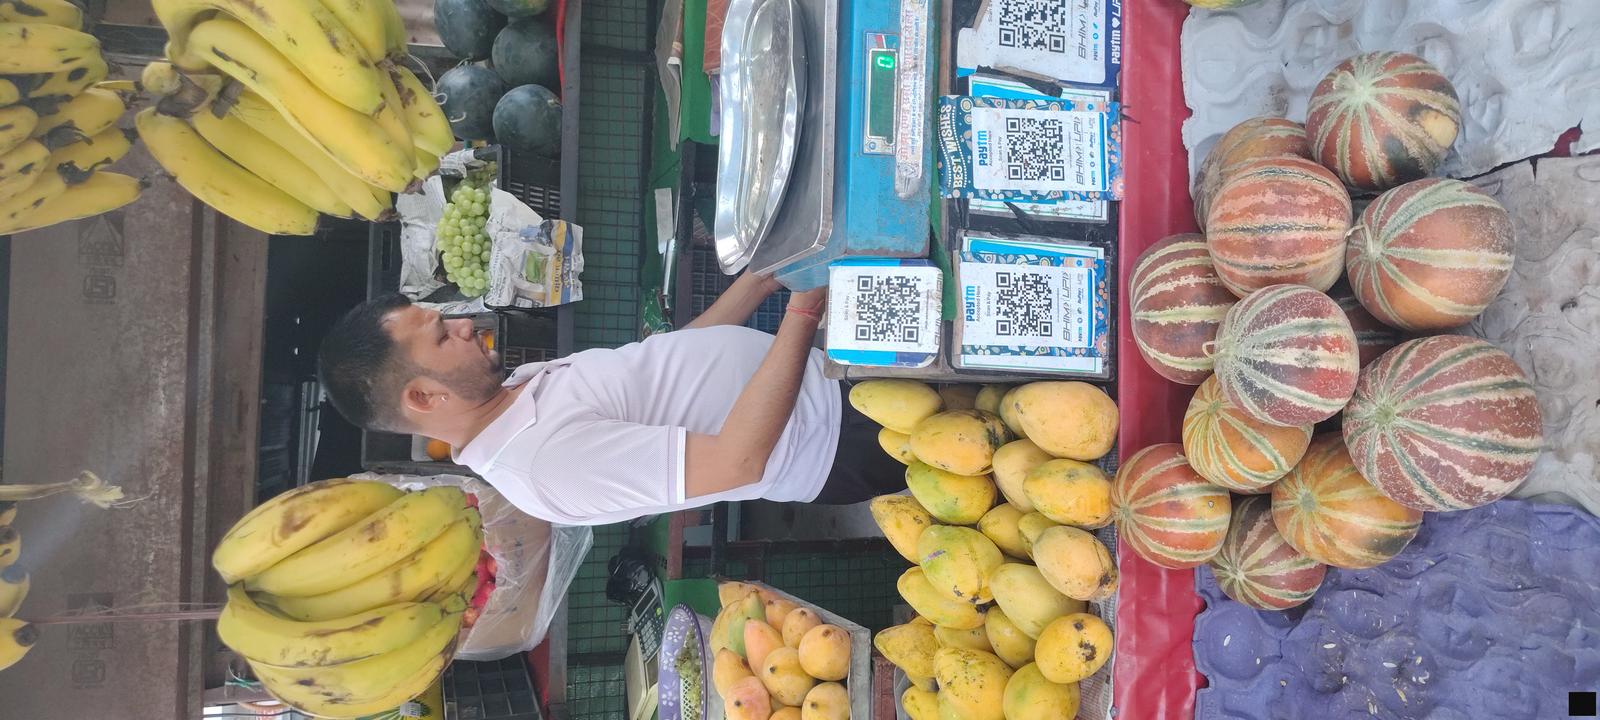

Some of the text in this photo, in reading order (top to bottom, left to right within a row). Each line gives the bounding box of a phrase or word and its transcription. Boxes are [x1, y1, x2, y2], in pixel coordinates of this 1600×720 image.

[877, 56, 894, 69] 0
[1078, 19, 1087, 59] BHIM
[939, 104, 964, 188] BEST WISHES
[1073, 119, 1084, 185] BHIM UPI
[1062, 276, 1071, 341] BHIM UPI
